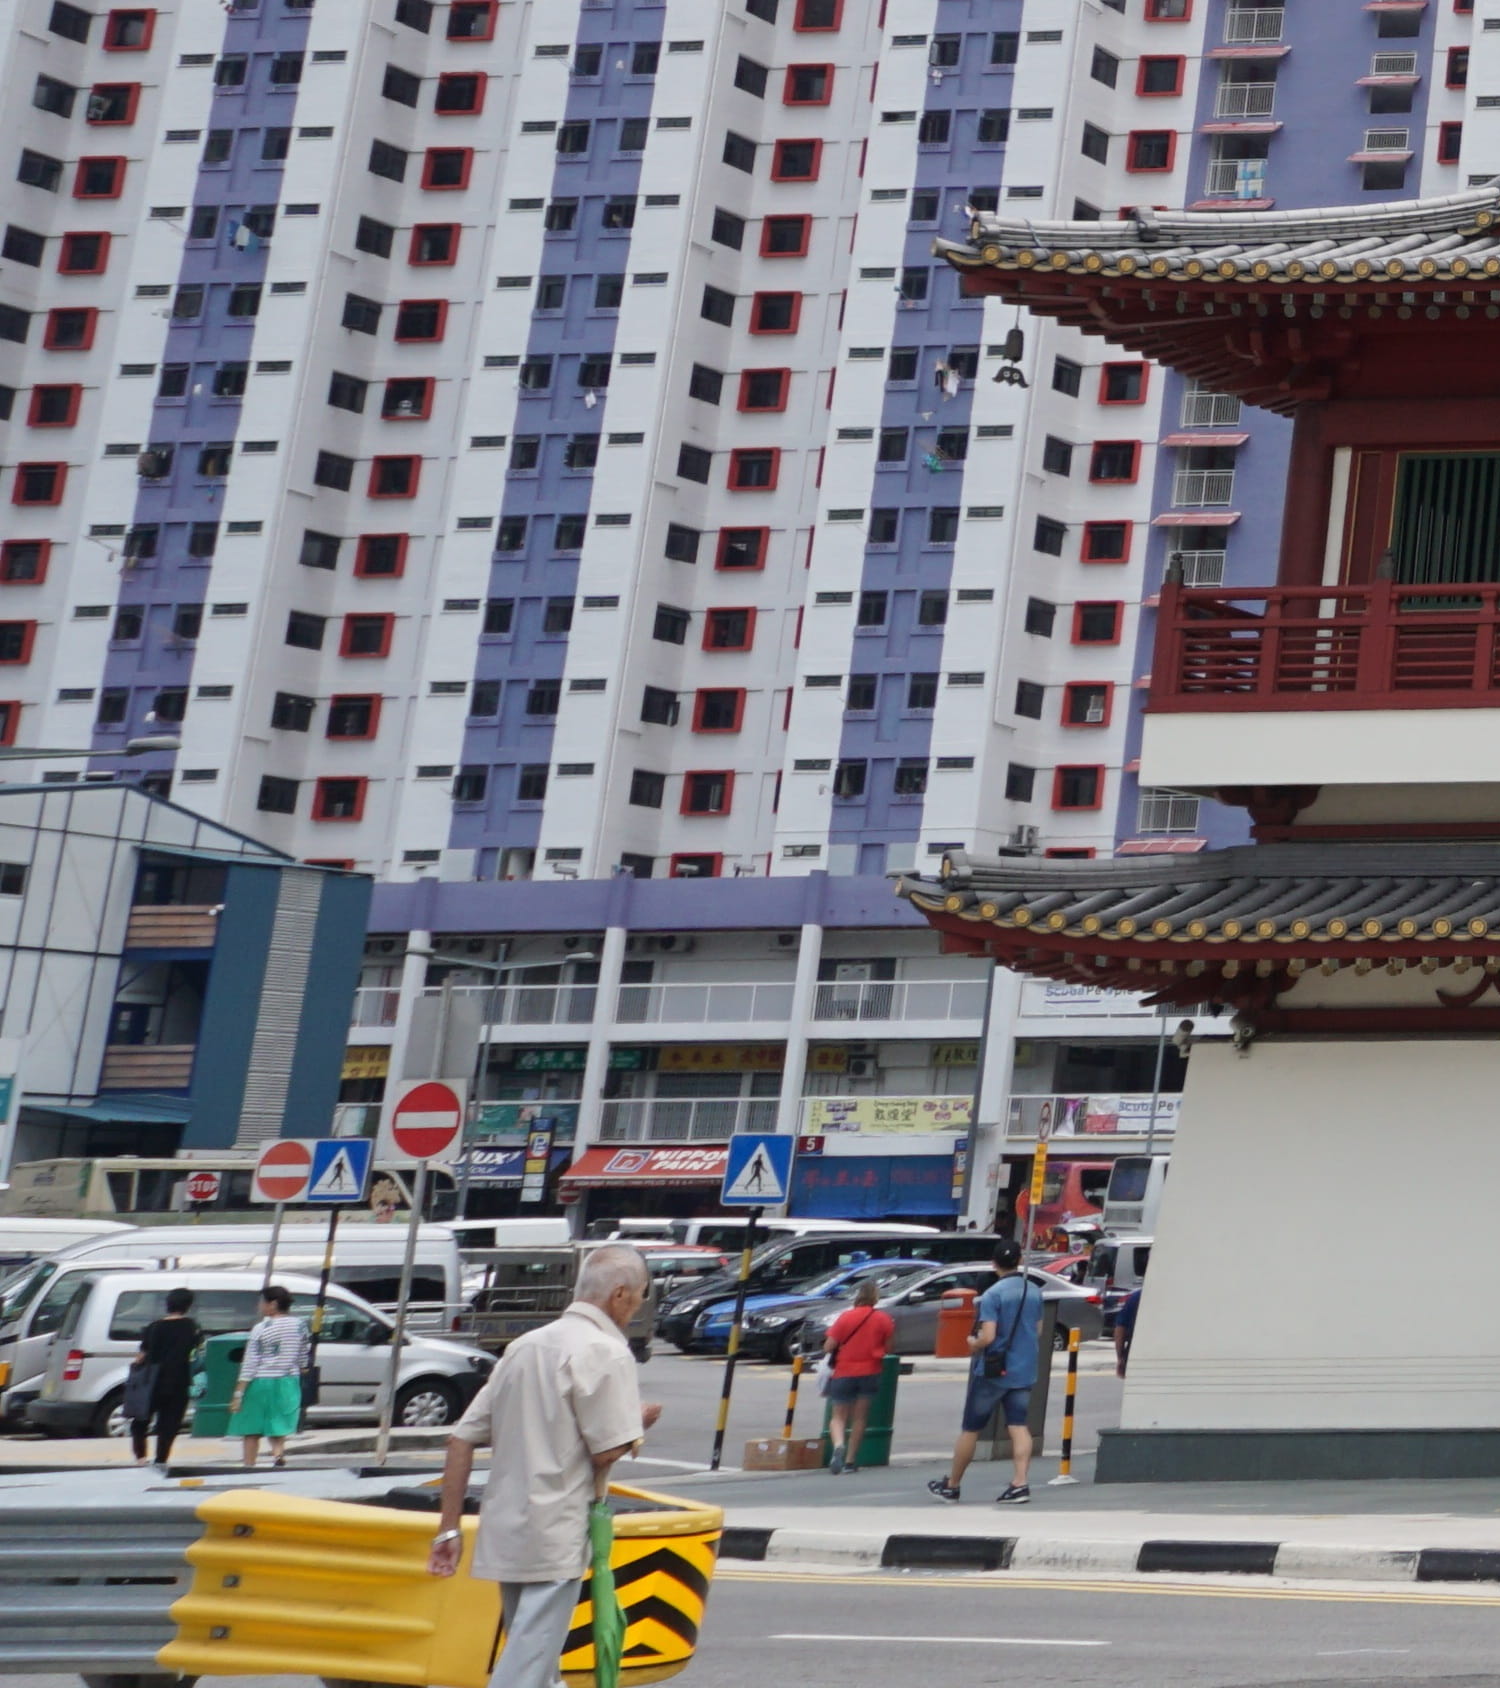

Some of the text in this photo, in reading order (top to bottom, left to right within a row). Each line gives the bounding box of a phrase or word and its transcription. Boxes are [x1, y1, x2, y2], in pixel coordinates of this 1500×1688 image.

[805, 1138, 816, 1151] 5
[650, 1161, 720, 1171] PAINT
[186, 1180, 220, 1193] STOP
